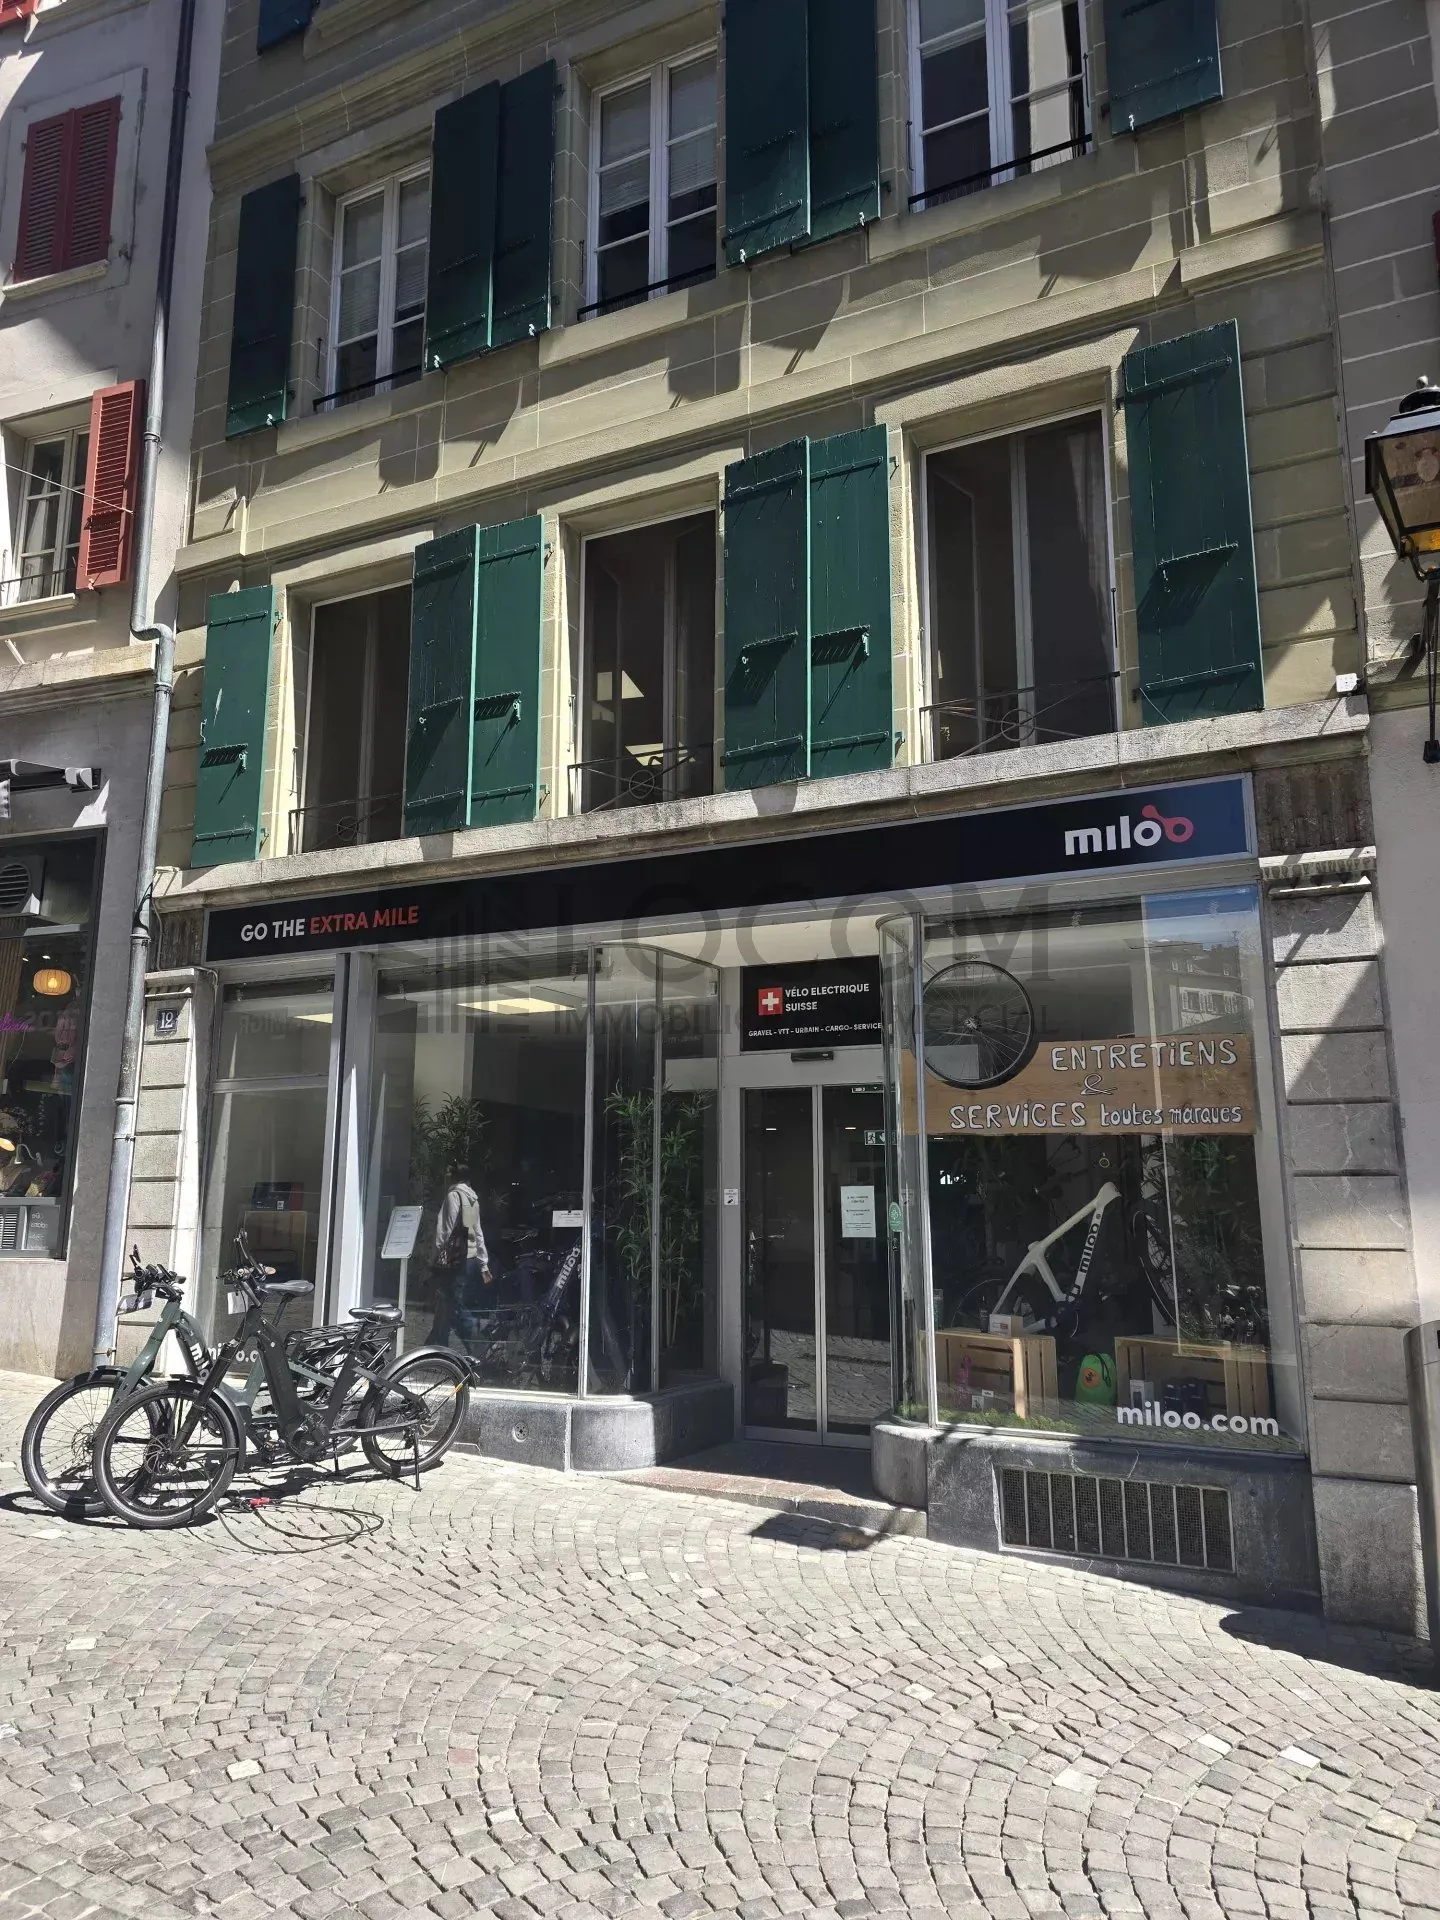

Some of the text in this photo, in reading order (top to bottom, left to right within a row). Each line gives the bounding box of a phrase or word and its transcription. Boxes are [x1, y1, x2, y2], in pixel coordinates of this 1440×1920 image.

[241, 905, 420, 942] GO THE EXTRA MILE
[785, 983, 870, 998] VÉLO ELECTRIQUE
[785, 1001, 818, 1012] SUISSE
[160, 1011, 174, 1029] 12
[748, 1028, 773, 1037] GRAVEL
[778, 1028, 789, 1036] VTT
[795, 1026, 819, 1034] URBAIN
[1080, 1072, 1119, 1096] &
[1116, 1400, 1280, 1437] miloo.com
